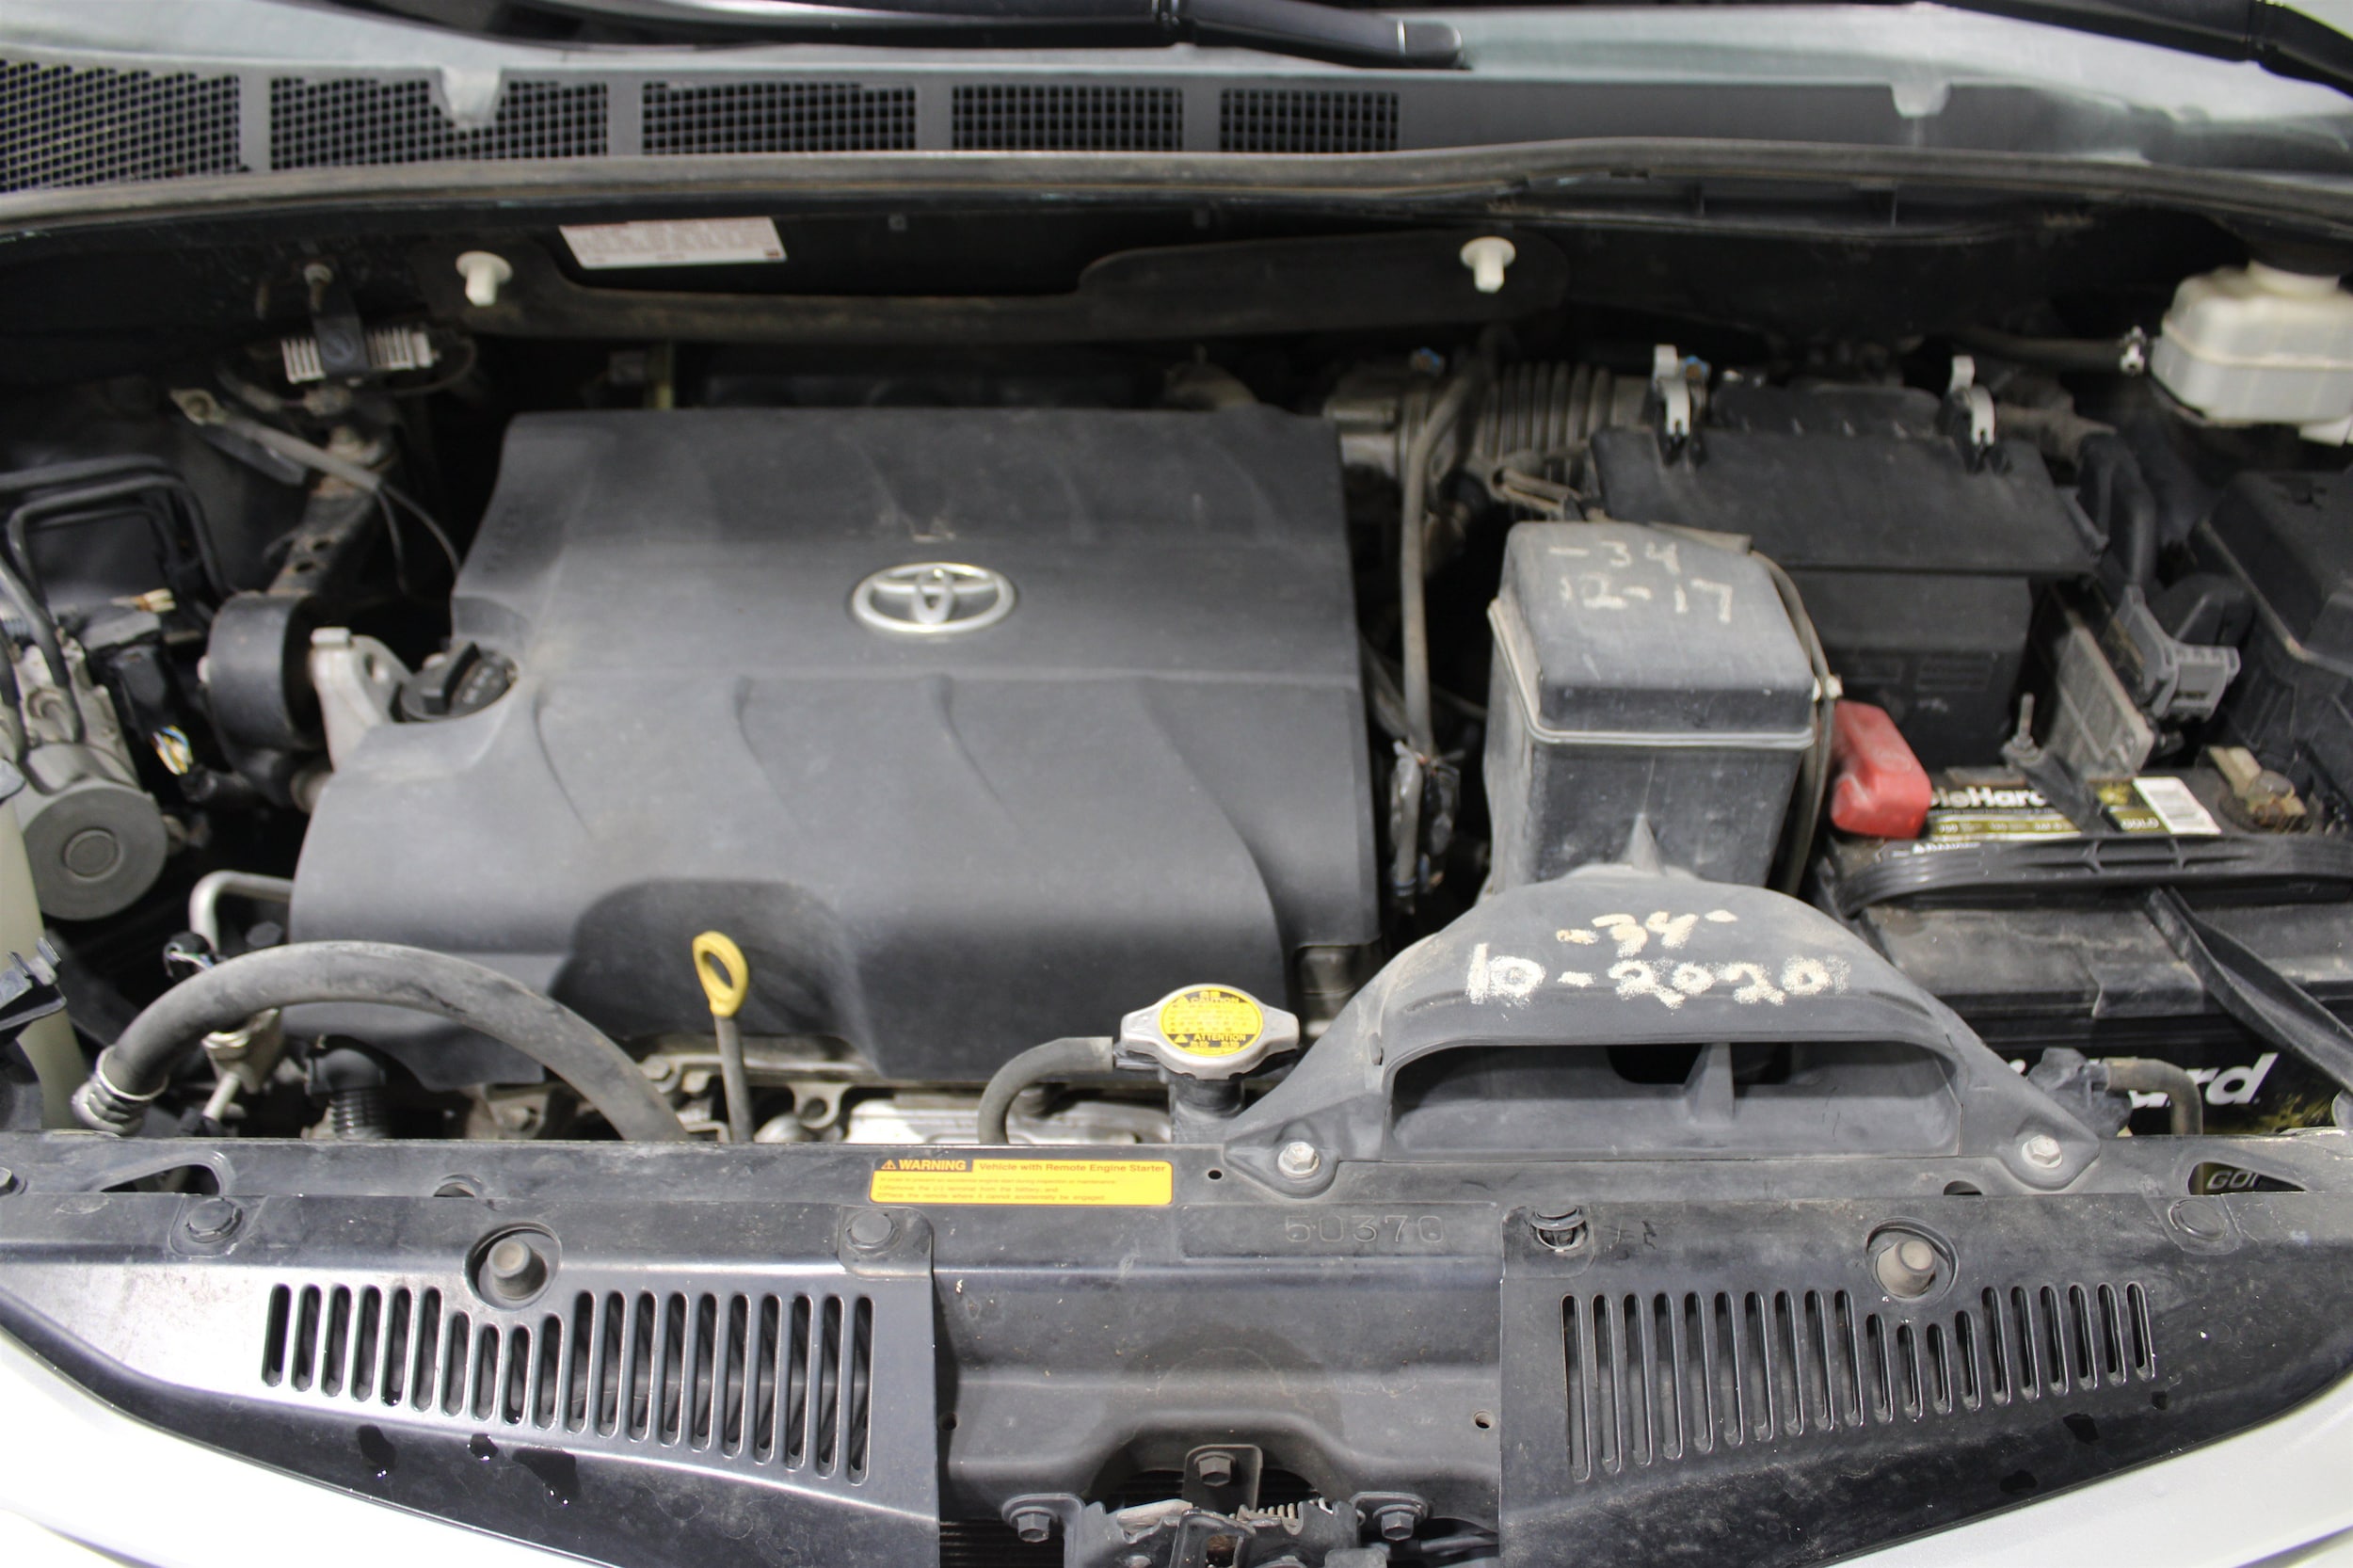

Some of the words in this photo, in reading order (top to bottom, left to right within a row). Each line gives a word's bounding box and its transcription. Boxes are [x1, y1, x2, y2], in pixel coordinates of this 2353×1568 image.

[899, 1160, 967, 1170] WARNING
[1046, 1163, 1086, 1172] Remote
[1089, 1164, 1127, 1174] Engine
[1286, 1215, 1444, 1243] 50370
